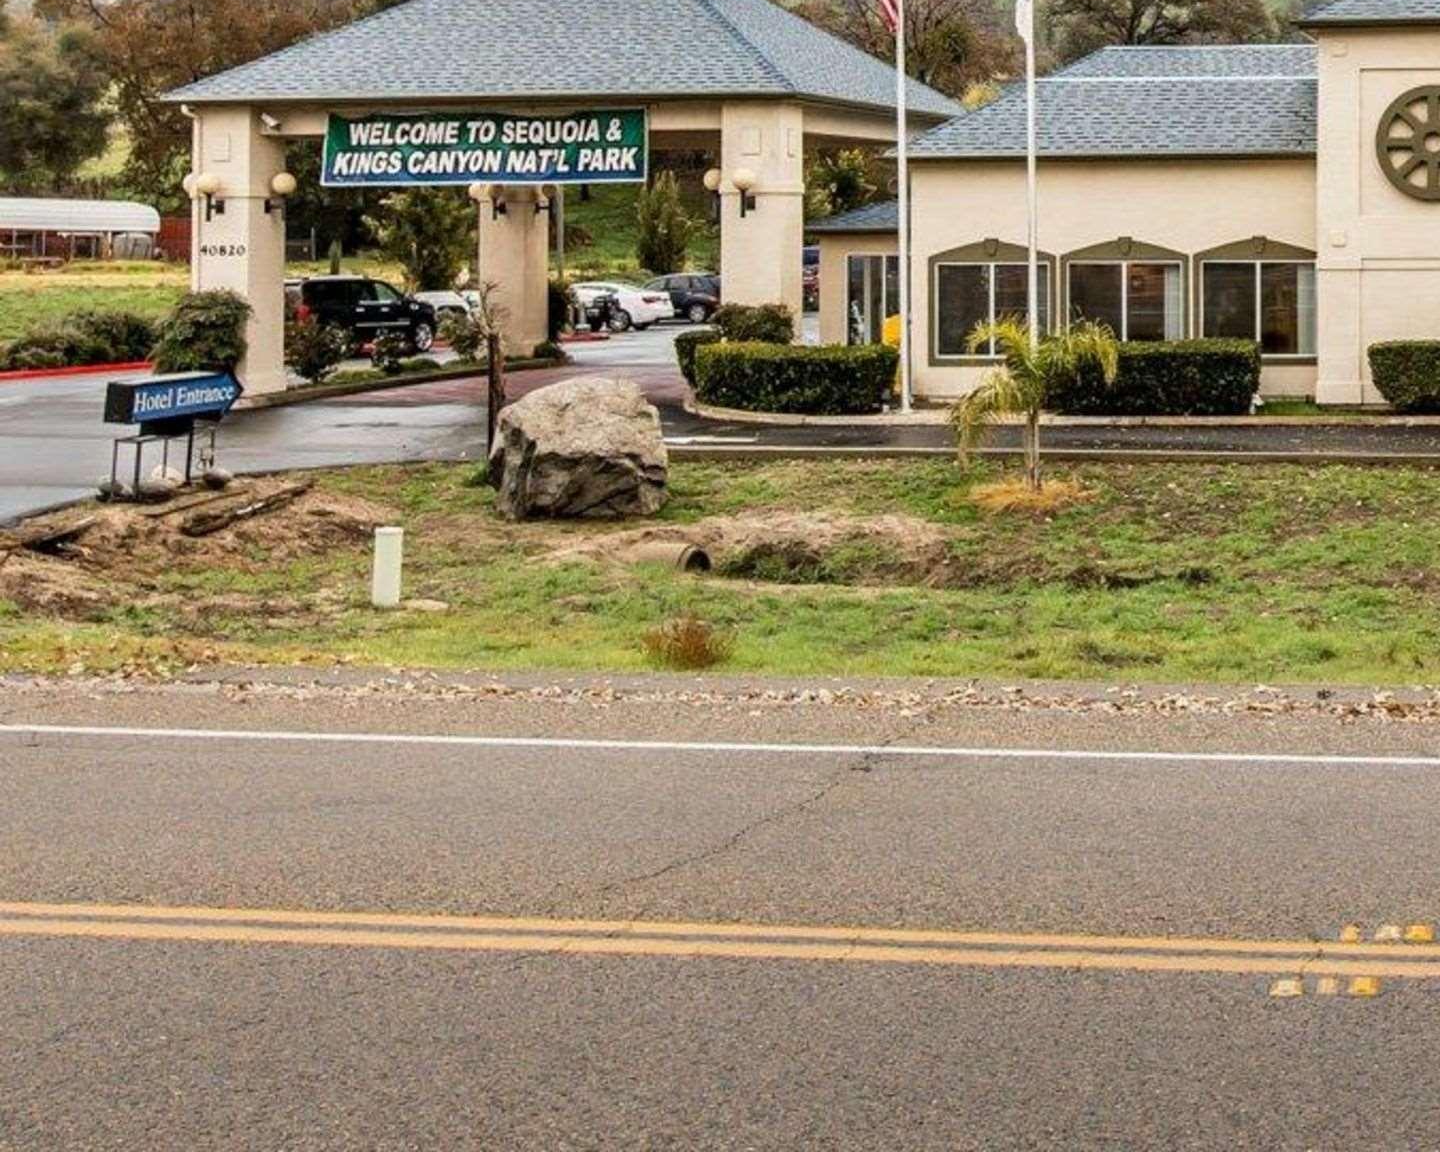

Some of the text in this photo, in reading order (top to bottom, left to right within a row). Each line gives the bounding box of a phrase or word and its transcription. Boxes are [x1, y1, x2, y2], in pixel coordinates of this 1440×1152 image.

[350, 118, 623, 145] WELCOME TO SEQUOIA &
[333, 147, 638, 175] KINGS CANYON NAT'L PARK
[200, 244, 246, 257] 40820
[133, 385, 235, 413] Hotel Entrance
